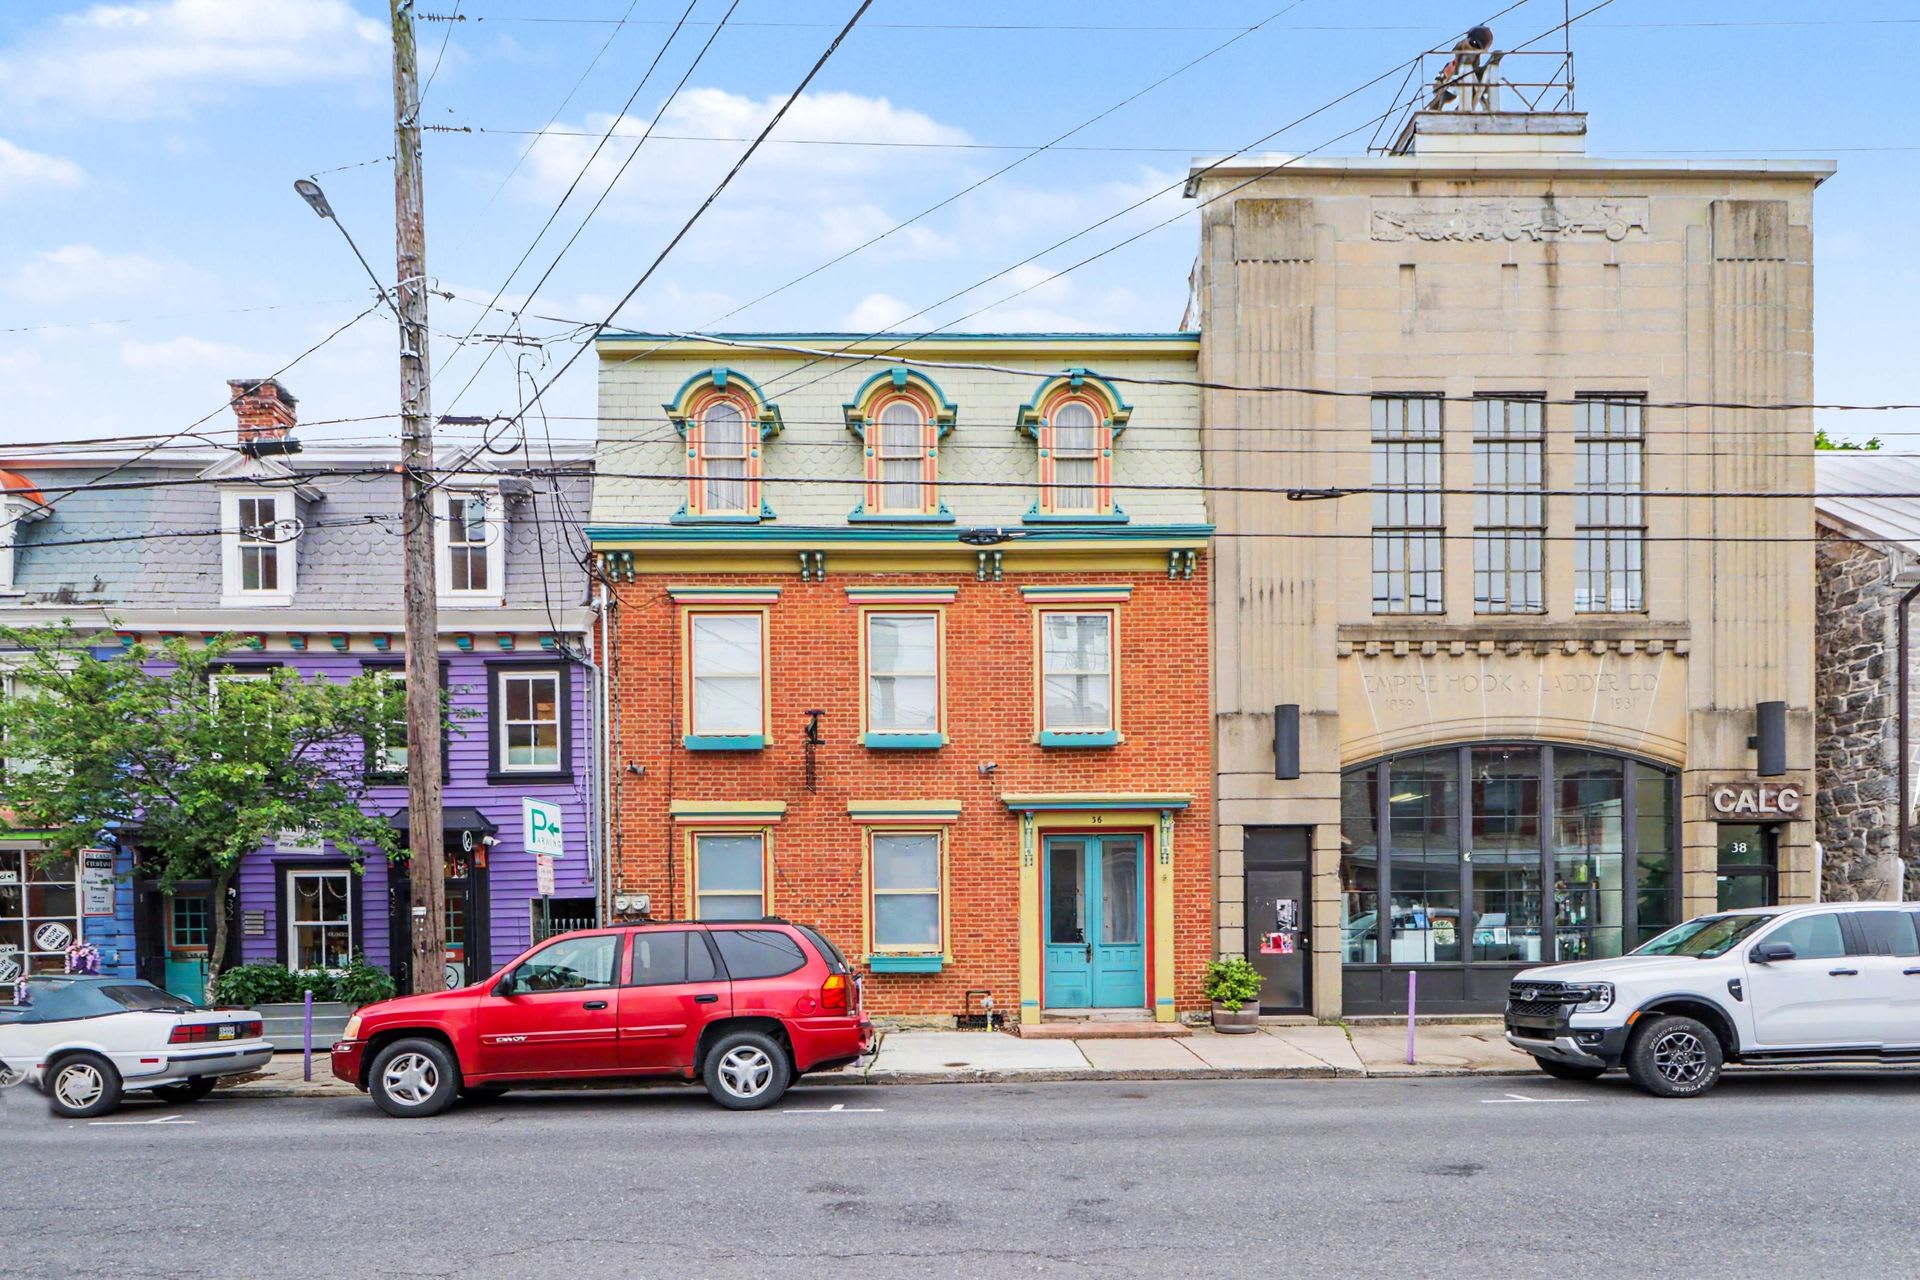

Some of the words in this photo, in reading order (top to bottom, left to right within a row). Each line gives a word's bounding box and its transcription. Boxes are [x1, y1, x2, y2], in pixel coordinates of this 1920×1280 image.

[1363, 674, 1437, 693] EMPIRE
[1445, 674, 1511, 693] HOOK
[1519, 680, 1531, 690] &
[1538, 673, 1618, 692] LADDER
[1713, 788, 1799, 812] CALC
[1091, 815, 1103, 824] 36
[1731, 842, 1748, 853] 38
